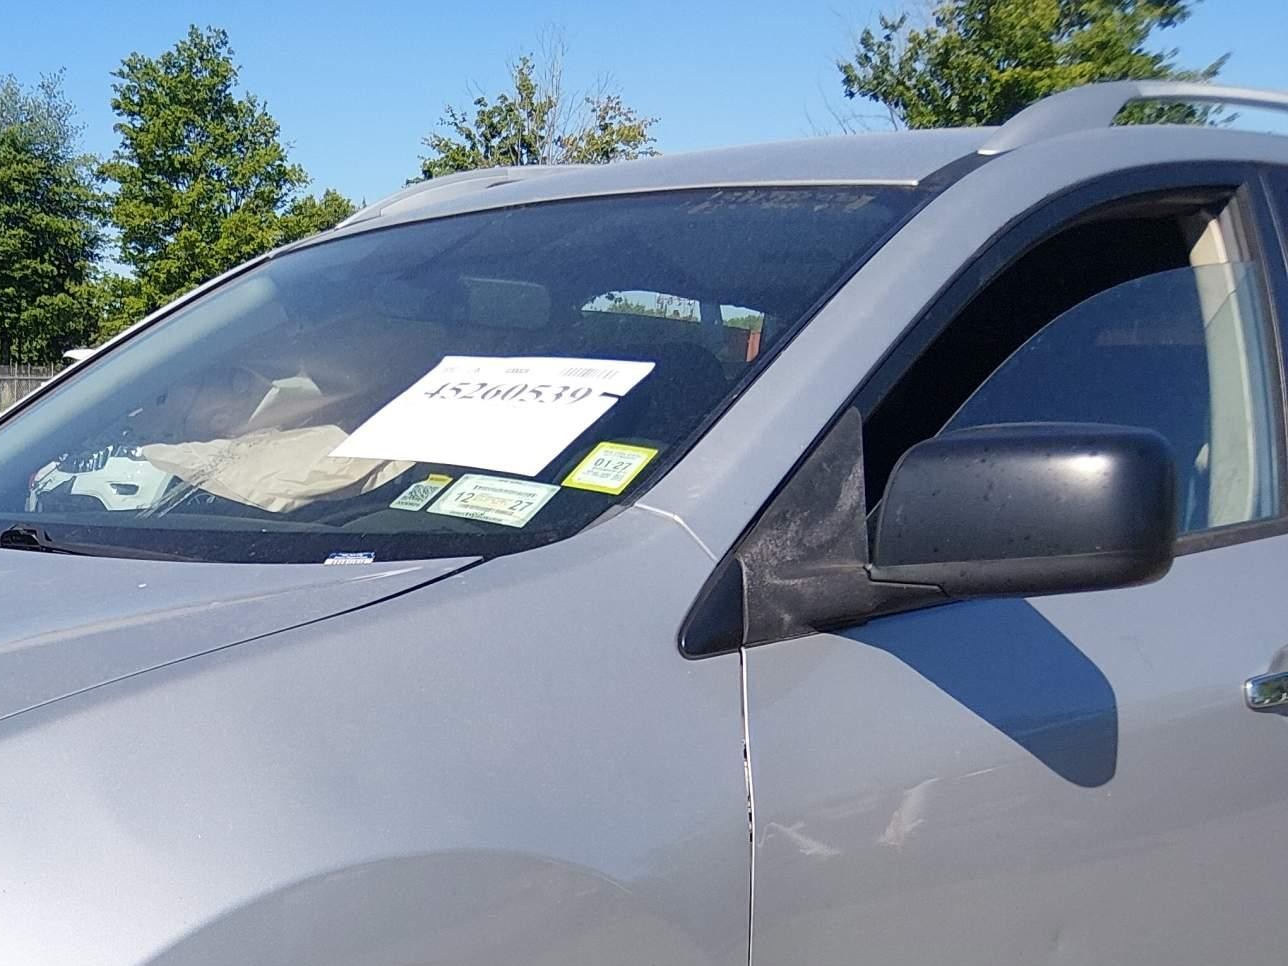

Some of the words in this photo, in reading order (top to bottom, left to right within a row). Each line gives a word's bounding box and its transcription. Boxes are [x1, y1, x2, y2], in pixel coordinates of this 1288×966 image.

[424, 382, 593, 405] 45260539
[454, 492, 475, 504] 12
[509, 500, 534, 512] 27
